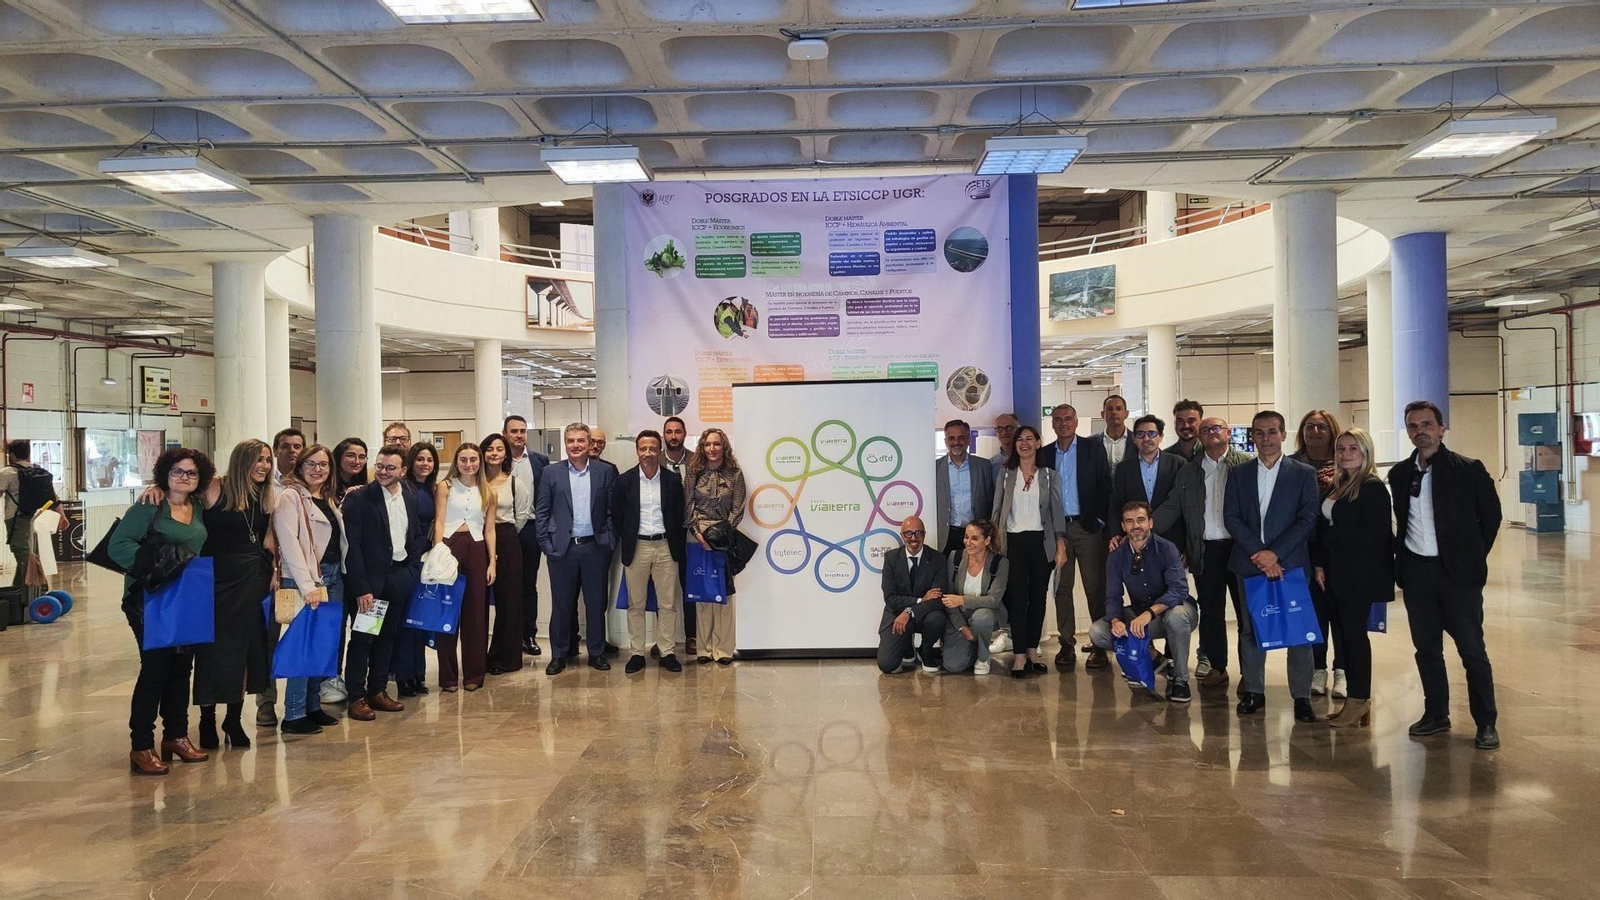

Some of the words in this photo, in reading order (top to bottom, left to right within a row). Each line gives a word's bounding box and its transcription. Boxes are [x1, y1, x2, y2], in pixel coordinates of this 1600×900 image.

[976, 179, 991, 188] ETS
[658, 193, 675, 206] ugr
[704, 192, 788, 204] POSGRADOS
[790, 191, 810, 203] EN
[812, 190, 830, 202] LA
[832, 189, 890, 202] ETSICCP
[892, 188, 925, 200] UGR:
[878, 454, 893, 462] dtd
